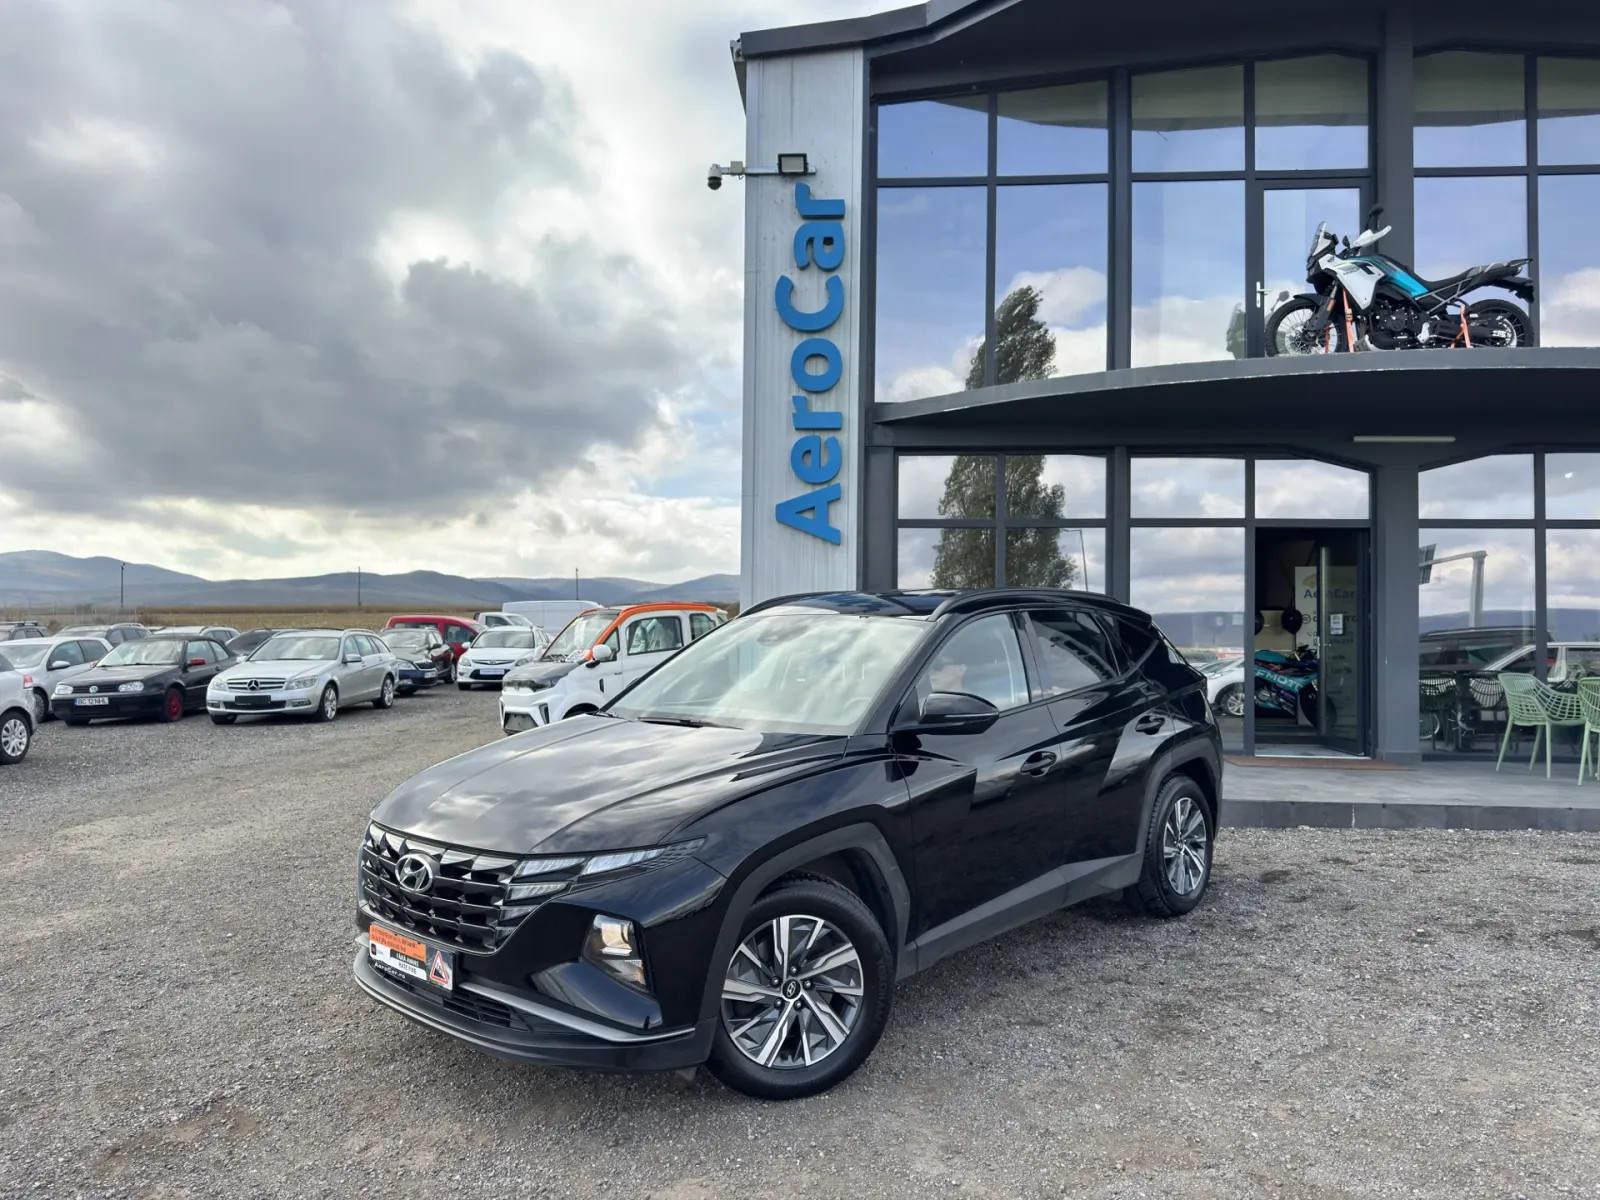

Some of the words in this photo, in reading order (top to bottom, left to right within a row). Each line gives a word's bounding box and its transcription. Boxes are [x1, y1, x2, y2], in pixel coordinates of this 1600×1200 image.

[775, 182, 846, 546] AeroCar
[1304, 588, 1355, 599] AoCar
[1255, 668, 1304, 691] FMOT
